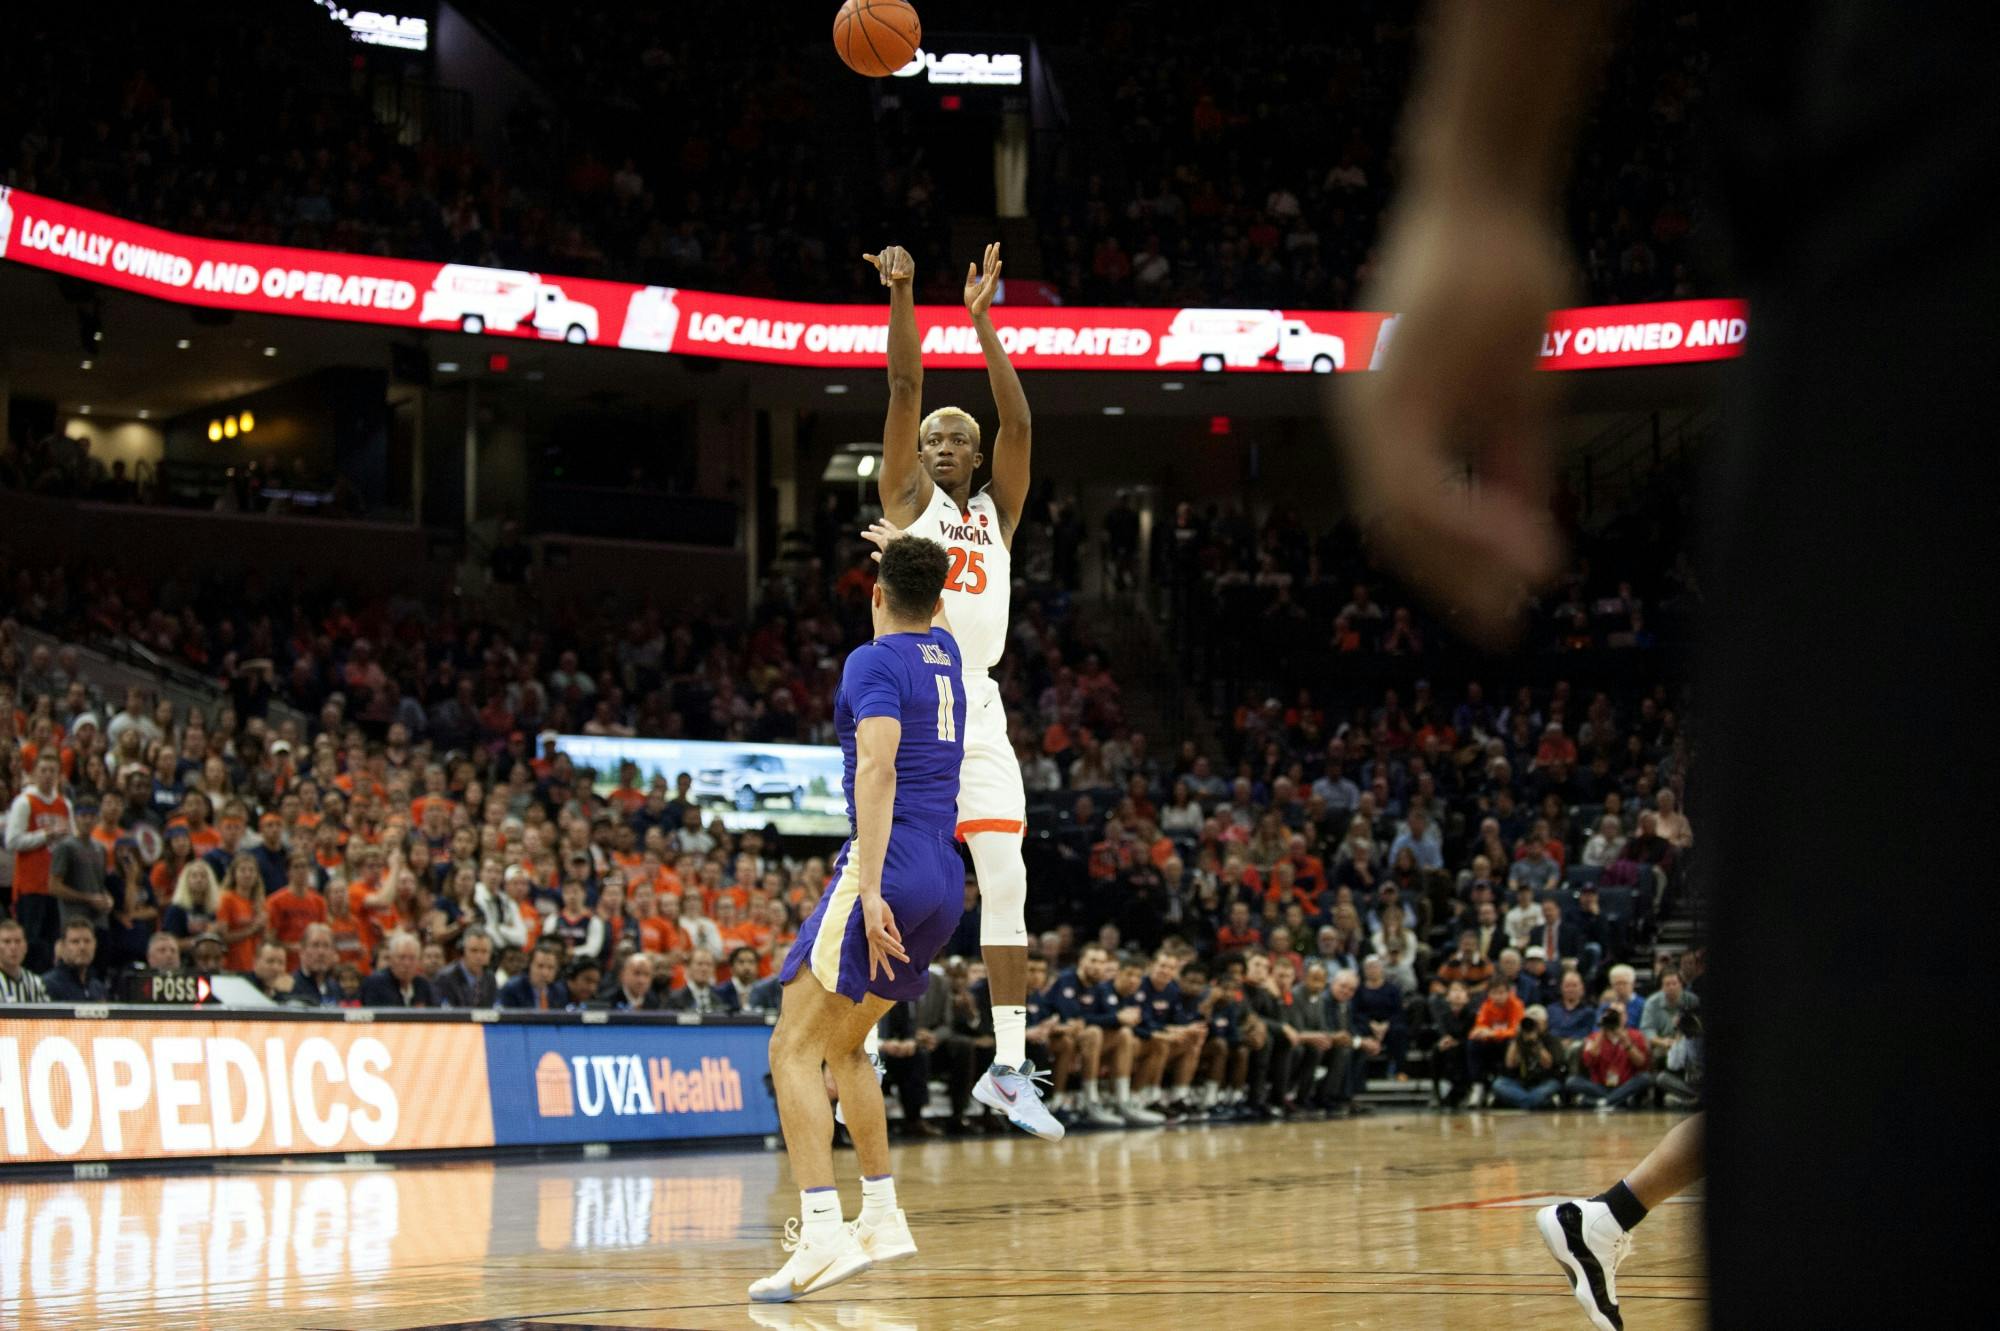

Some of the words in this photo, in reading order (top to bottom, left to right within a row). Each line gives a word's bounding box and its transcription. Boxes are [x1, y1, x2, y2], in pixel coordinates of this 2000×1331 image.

[20, 215, 114, 267] LOCALLY
[111, 241, 193, 288] OWNED
[192, 260, 260, 295] AND
[261, 267, 416, 310] OPERATED
[687, 311, 806, 350] LOCALLY
[997, 327, 1151, 355] OPERATED
[1573, 322, 1683, 356] OWNED
[1685, 318, 1747, 348] AND
[943, 546, 987, 595] 25
[934, 674, 956, 743] 11
[571, 1054, 656, 1117] UVA
[648, 1057, 743, 1114] Health
